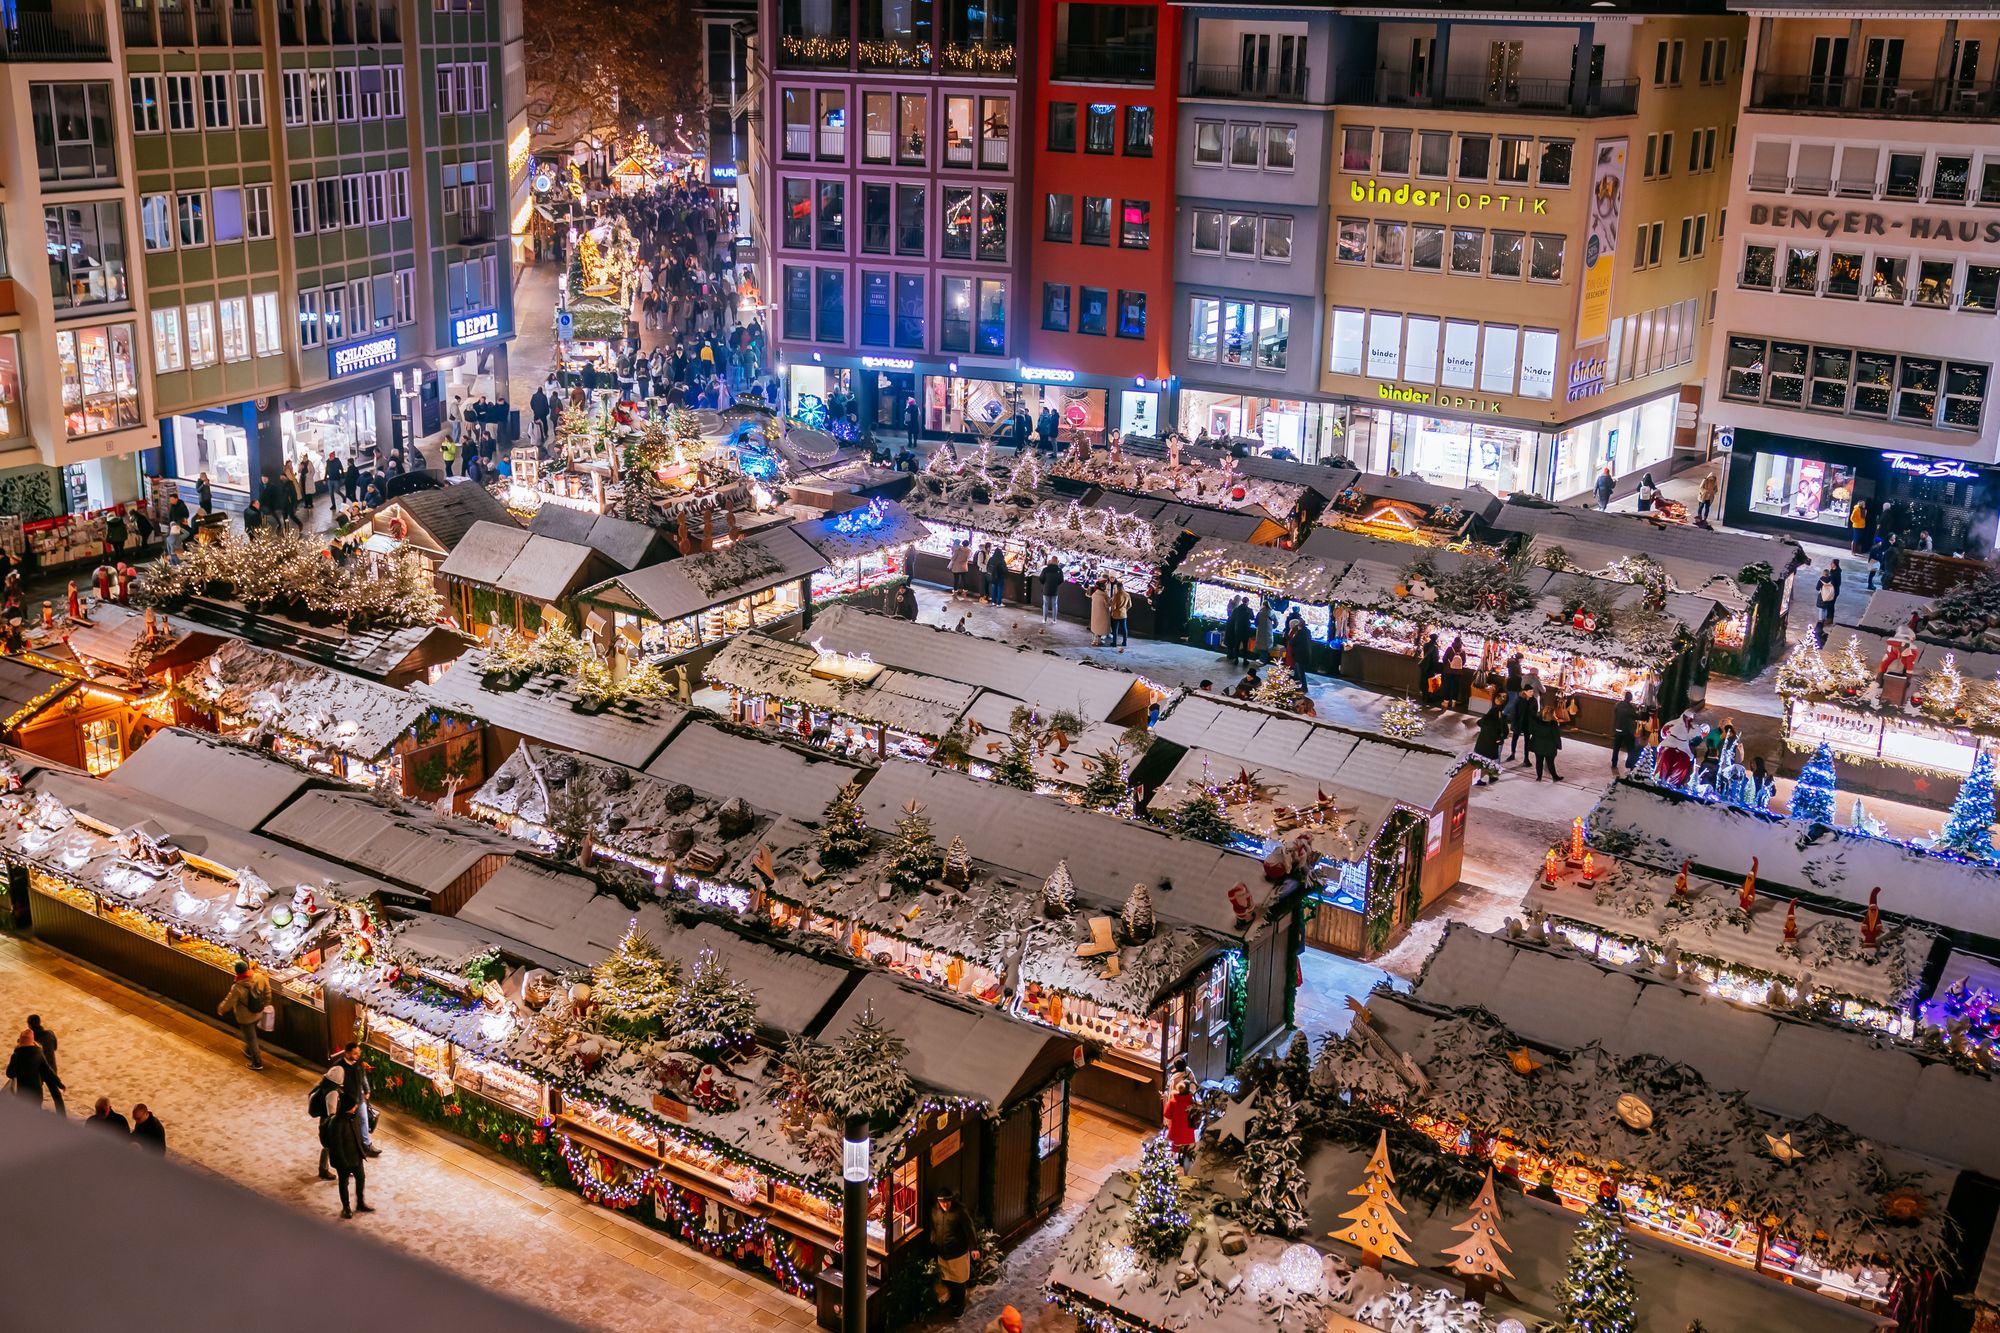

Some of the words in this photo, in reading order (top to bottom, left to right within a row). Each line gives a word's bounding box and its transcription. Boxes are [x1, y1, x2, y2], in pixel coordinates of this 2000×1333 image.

[1350, 180, 1441, 207] binder
[1456, 193, 1547, 215] OPTIK
[1750, 204, 2000, 244] BENGER-HAUS
[465, 312, 498, 336] EPPLI
[336, 338, 396, 362] SCHLOSSBERG
[1371, 349, 1397, 358] binder
[1447, 357, 1474, 367] binder
[336, 352, 397, 374] SWITZERLAND
[1021, 366, 1075, 381] NESPRESSO
[1525, 366, 1552, 376] binder
[1570, 358, 1606, 383] binder
[1378, 383, 1430, 404] binder
[1441, 396, 1501, 413] OPTIK
[1567, 383, 1605, 403] OPTIK
[1881, 453, 1932, 475] Thomas
[1925, 461, 1980, 479] Sabo
